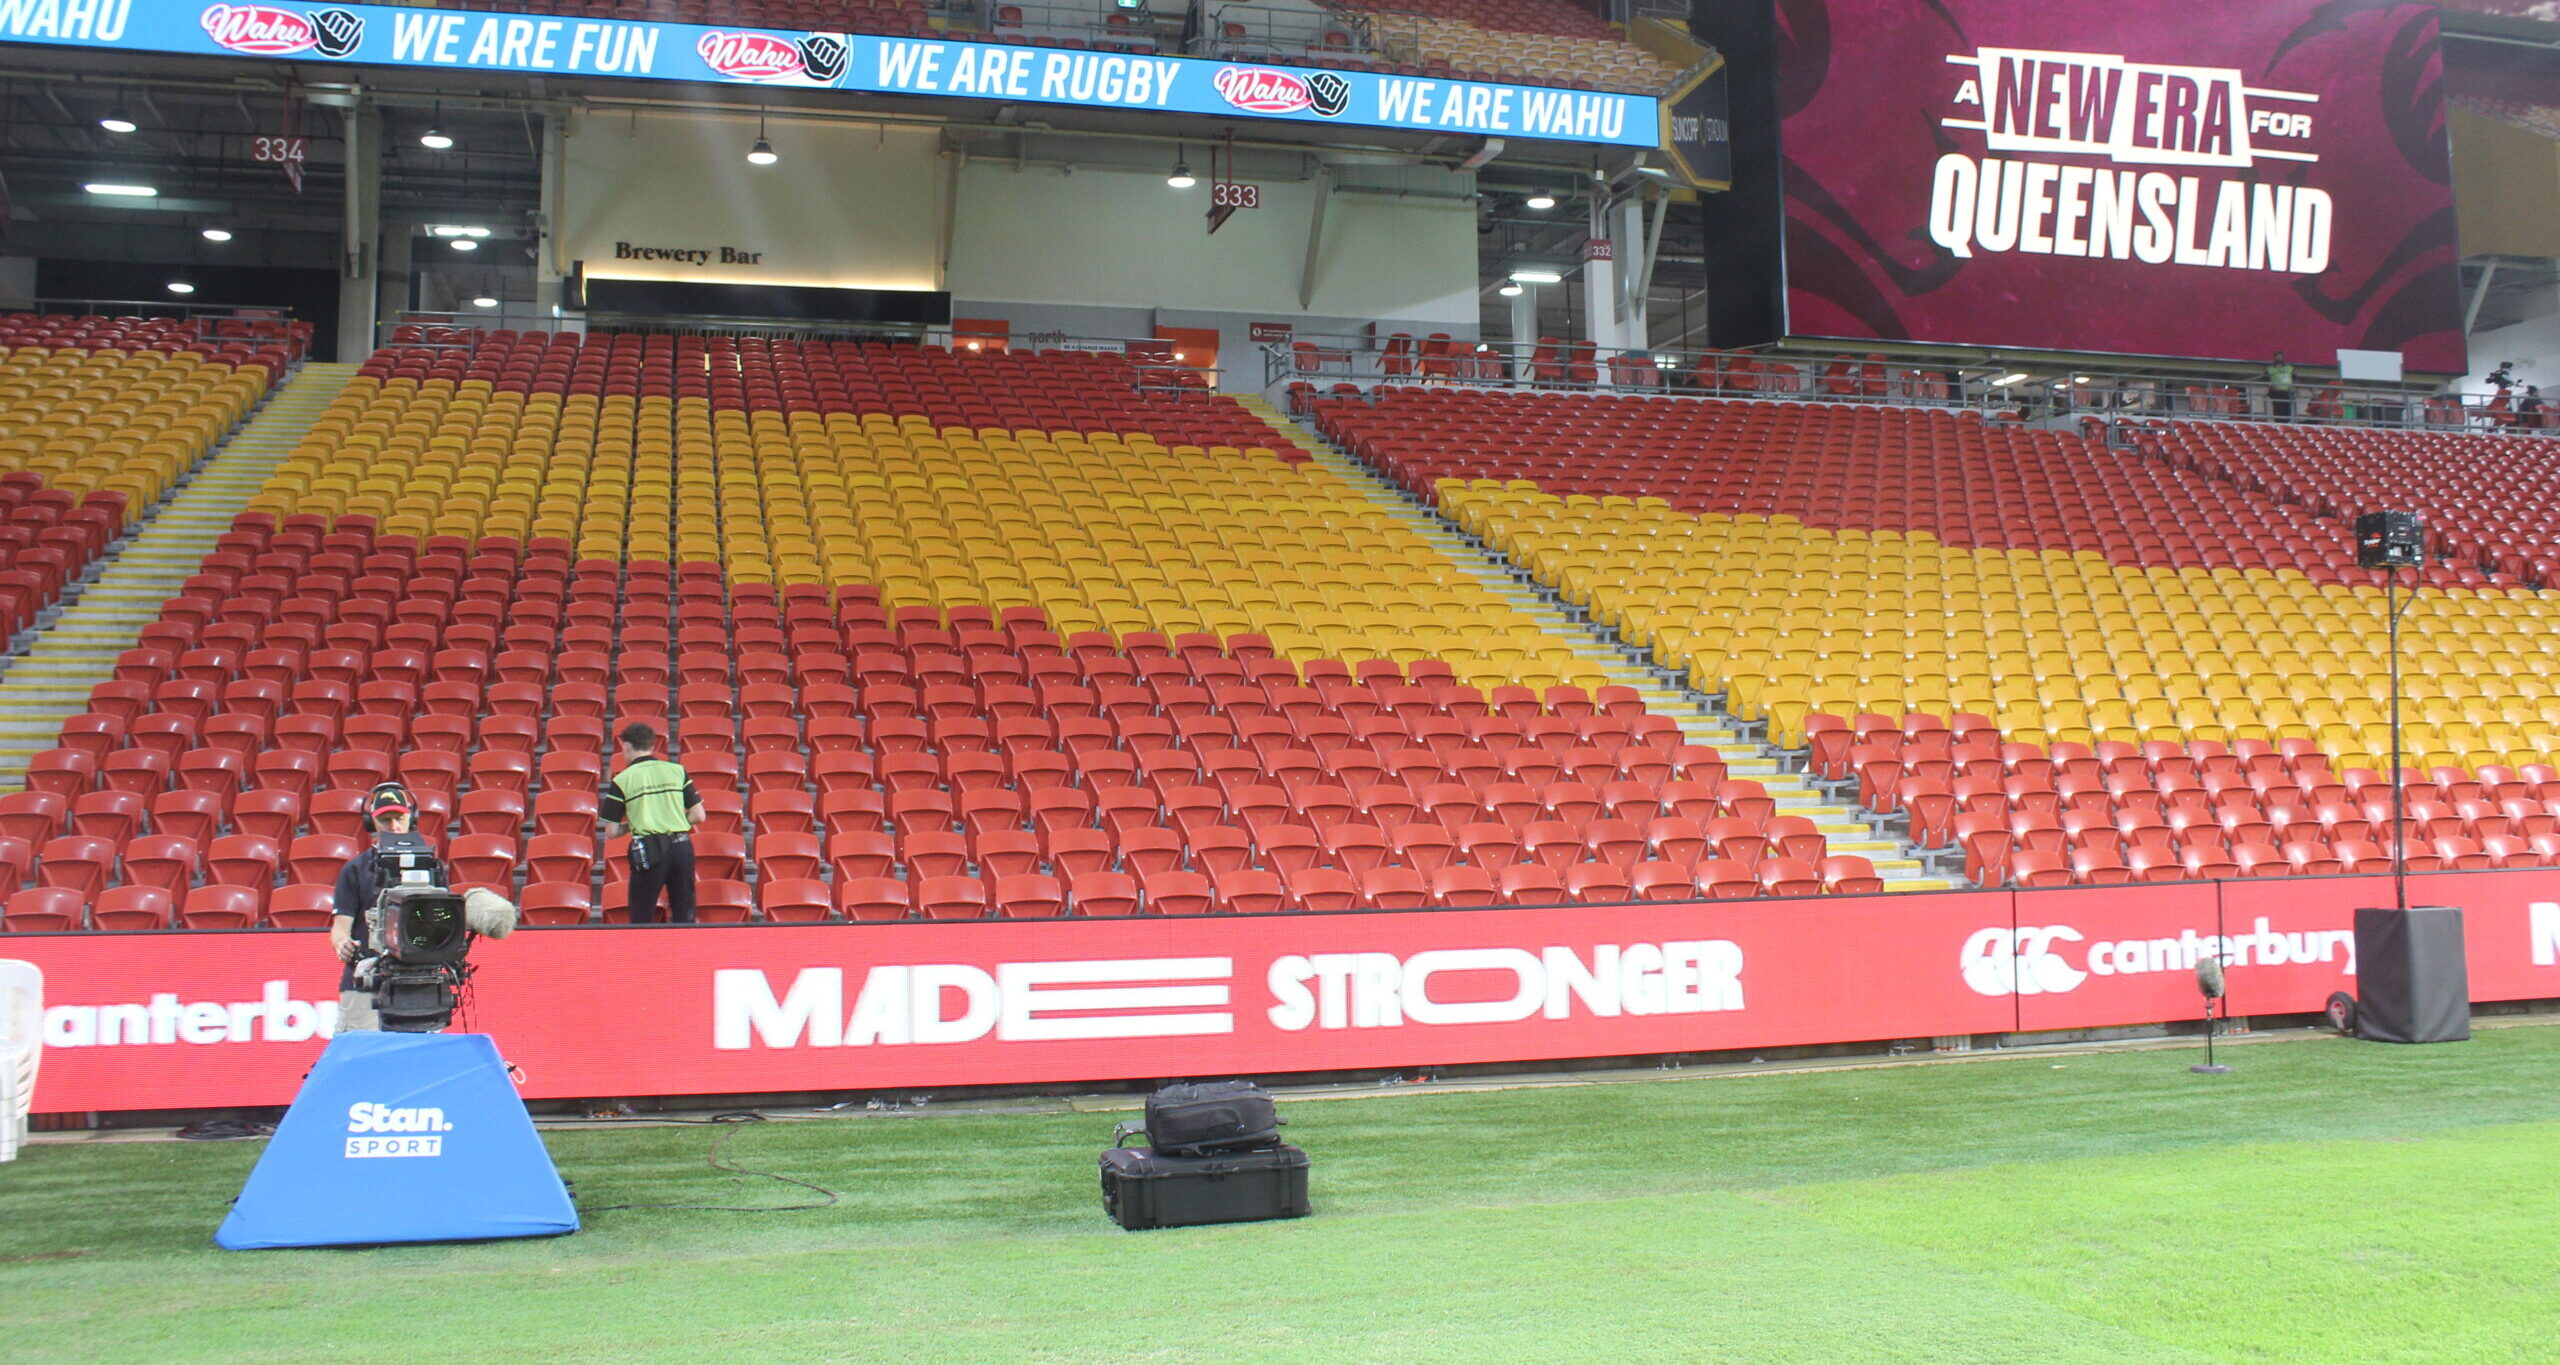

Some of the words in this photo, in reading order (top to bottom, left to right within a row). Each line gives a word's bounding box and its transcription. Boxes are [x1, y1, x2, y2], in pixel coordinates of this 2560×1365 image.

[0, 0, 131, 41] WAHU
[201, 3, 312, 43] Wahu
[393, 14, 465, 63] WE
[467, 18, 563, 68] ARE
[568, 24, 660, 74] FUN
[696, 31, 801, 68] Wahu
[878, 42, 945, 90] WE
[948, 47, 1034, 96] ARE
[1040, 53, 1181, 106] RUGBY
[1213, 67, 1307, 103] Wahu
[1378, 79, 1436, 124] WE
[1439, 84, 1514, 130] ARE
[1522, 90, 1626, 138] WAHU
[1954, 80, 1980, 105] A
[1993, 57, 2122, 144] NEW
[2132, 72, 2232, 156] ERA
[2250, 111, 2312, 138] FOR
[255, 137, 304, 162] 334
[1215, 184, 1256, 207] 333
[1930, 154, 2332, 274] QUEENSLAND
[615, 241, 711, 266] Brewery
[720, 246, 762, 264] Bar
[1592, 246, 1611, 257] 332
[2087, 916, 2355, 976] canterbury
[714, 957, 1234, 1050] MADE
[1267, 940, 1745, 1031] STRONGER
[349, 1139, 438, 1154] SPORT
